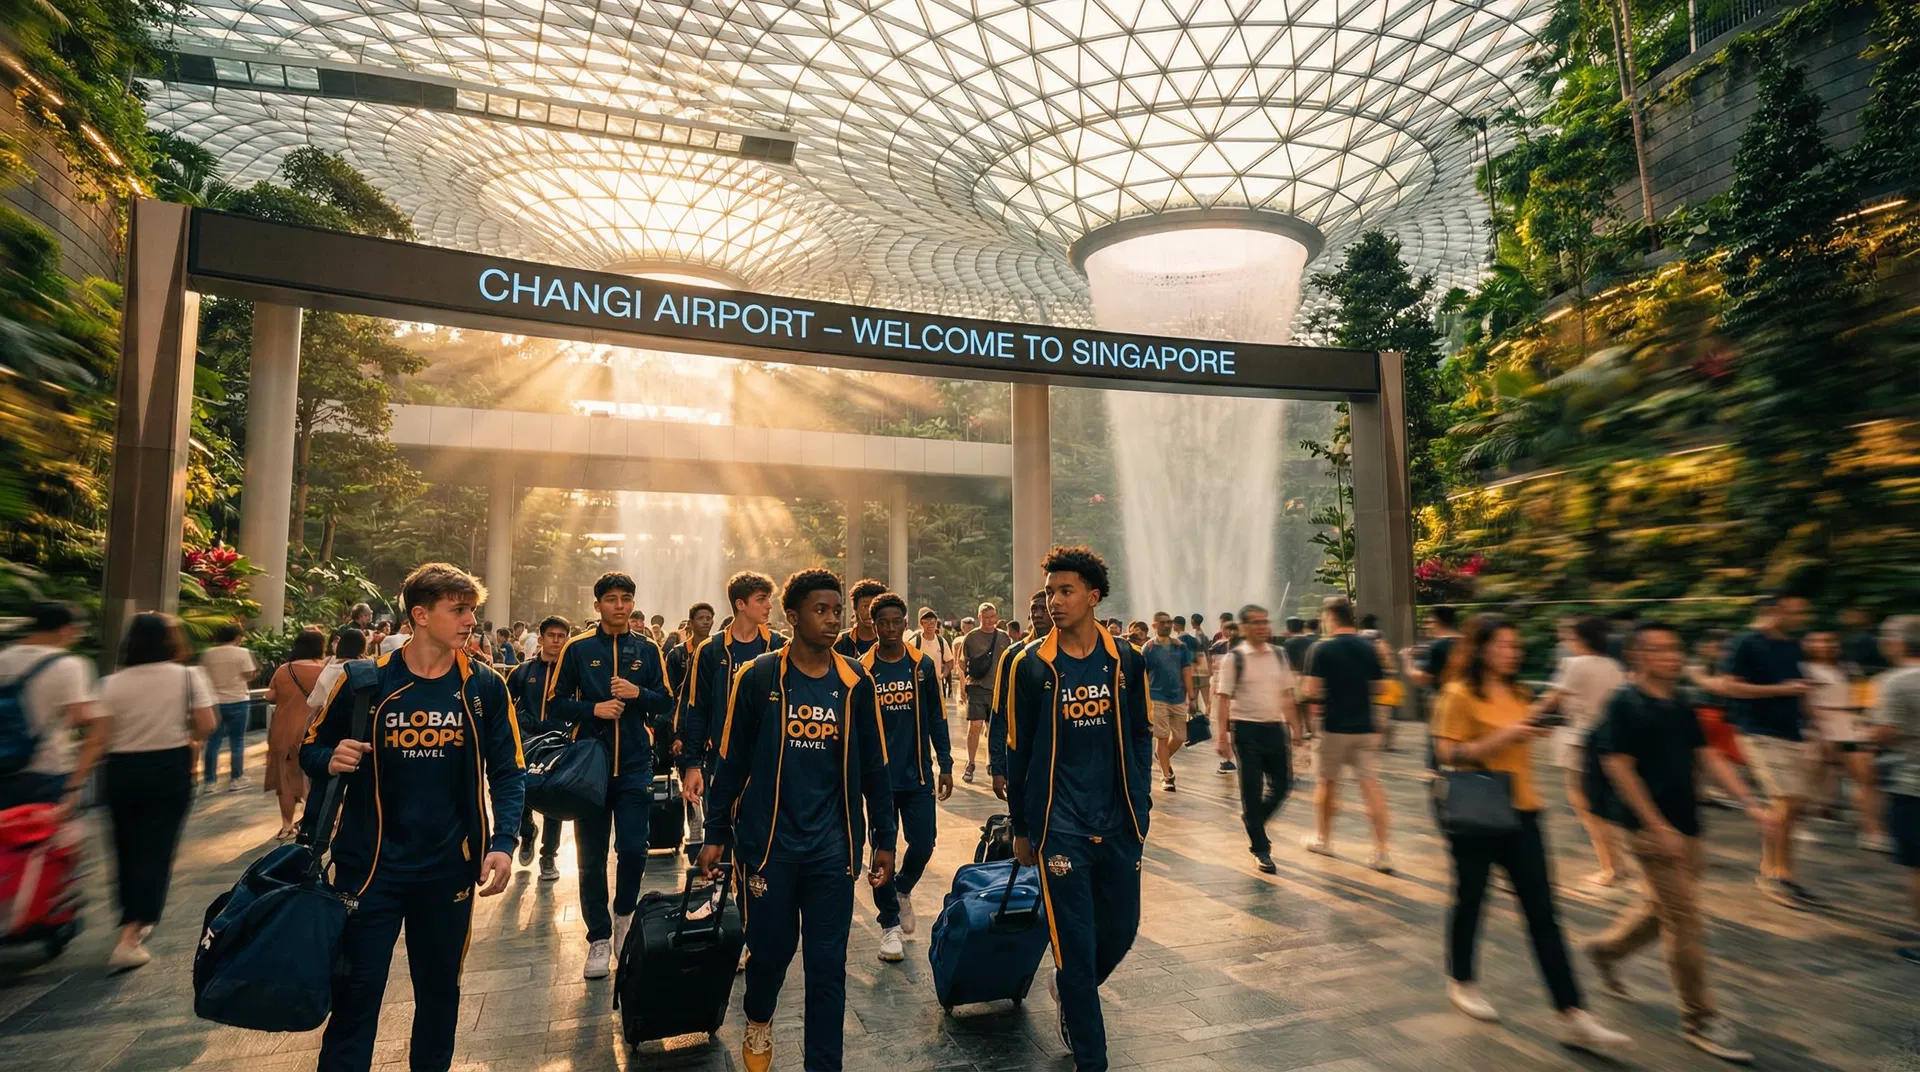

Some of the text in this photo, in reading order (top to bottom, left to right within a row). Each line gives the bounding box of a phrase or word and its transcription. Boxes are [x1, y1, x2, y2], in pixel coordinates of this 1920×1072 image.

[479, 268, 641, 319] CHANGI
[654, 294, 815, 338] AIRPORT
[851, 316, 1015, 359] WELCOME
[1023, 334, 1063, 363] TO
[1072, 339, 1235, 375] SINGAPORE
[876, 681, 913, 693] GLOBA
[1062, 684, 1110, 702] LOBA
[788, 704, 836, 721] LOBA
[1073, 717, 1107, 728] TRAVEL
[384, 728, 464, 748] HOOPS
[789, 740, 826, 750] TRAVEL
[402, 749, 445, 758] TRAVEL
